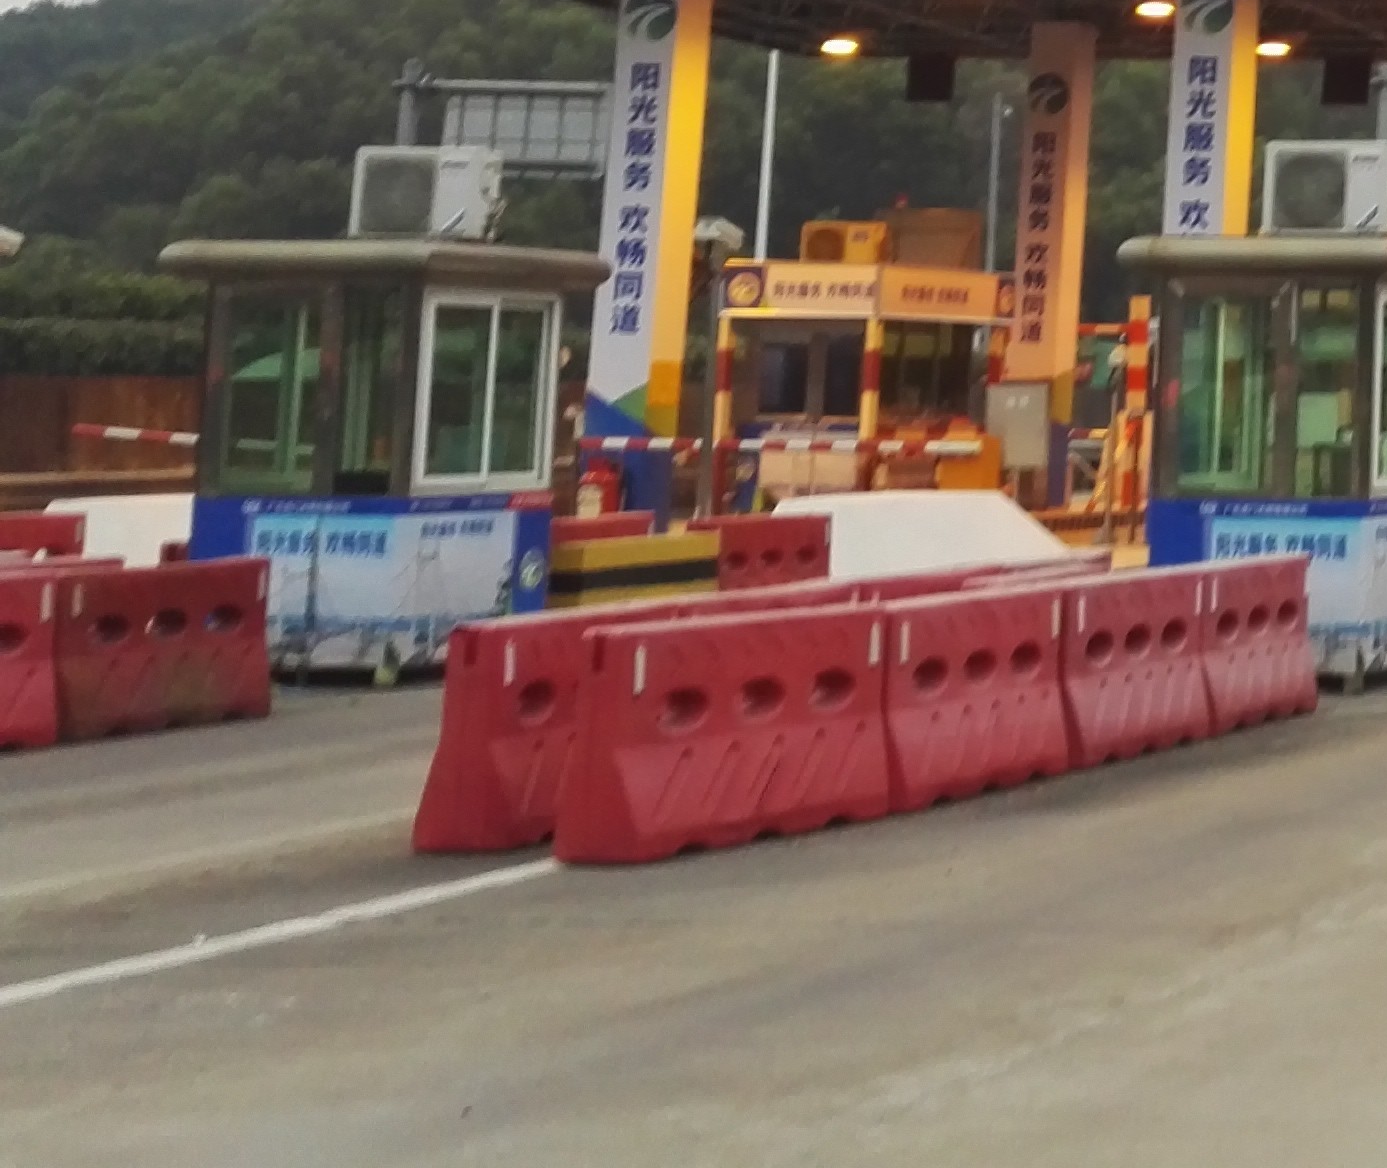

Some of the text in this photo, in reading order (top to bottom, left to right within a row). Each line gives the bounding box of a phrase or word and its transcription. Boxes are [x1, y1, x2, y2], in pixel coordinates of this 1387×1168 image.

[609, 62, 661, 335] 阳光服务 欢畅同道
[1179, 55, 1218, 235] 阳光服务 欢
